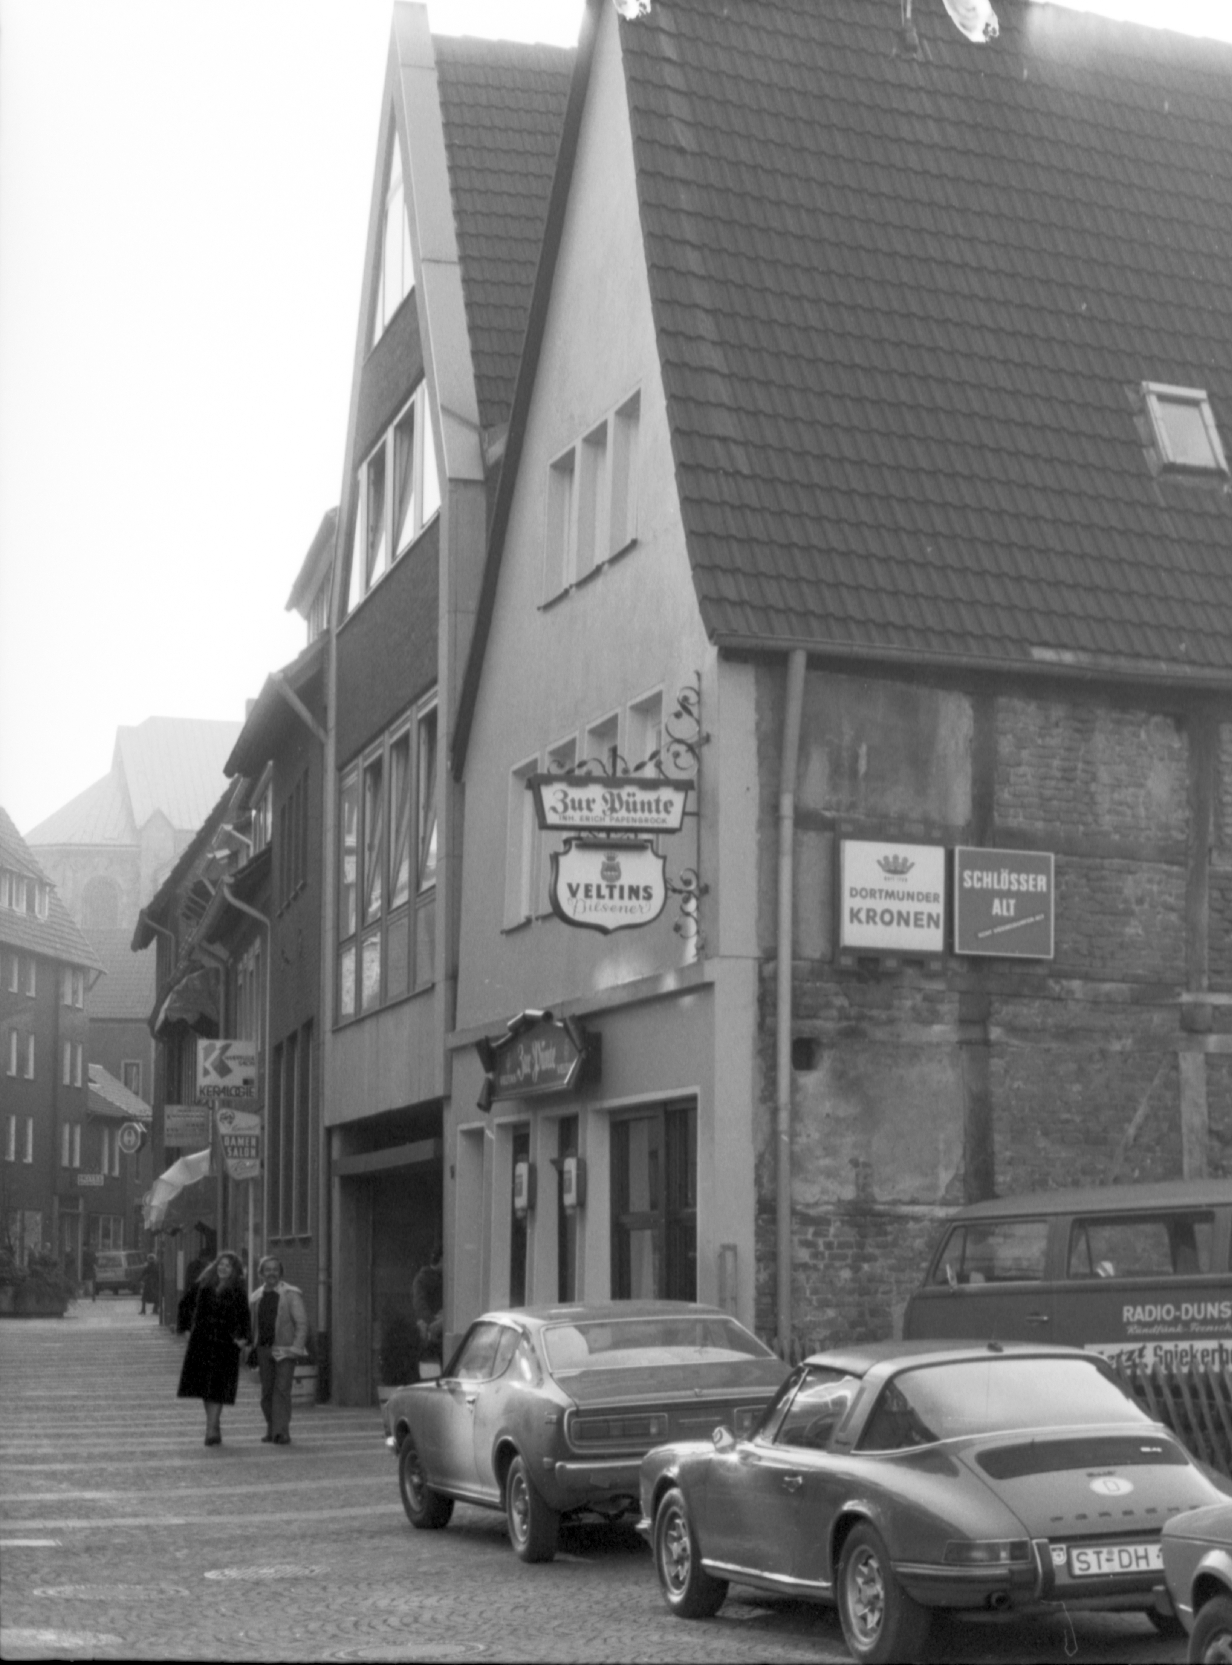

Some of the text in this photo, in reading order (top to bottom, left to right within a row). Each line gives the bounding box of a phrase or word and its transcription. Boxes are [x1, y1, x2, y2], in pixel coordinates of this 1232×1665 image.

[550, 790, 675, 817] Zur Pünte
[963, 868, 1047, 893] SCHLÖSSER
[566, 883, 654, 901] VELTINS
[849, 886, 941, 904] DORTMUNDER
[567, 897, 652, 917] Pilsener
[991, 898, 1016, 917] ALT
[849, 907, 941, 930] KRONEN
[224, 1136, 256, 1147] DAMEN
[227, 1147, 256, 1157] SALON
